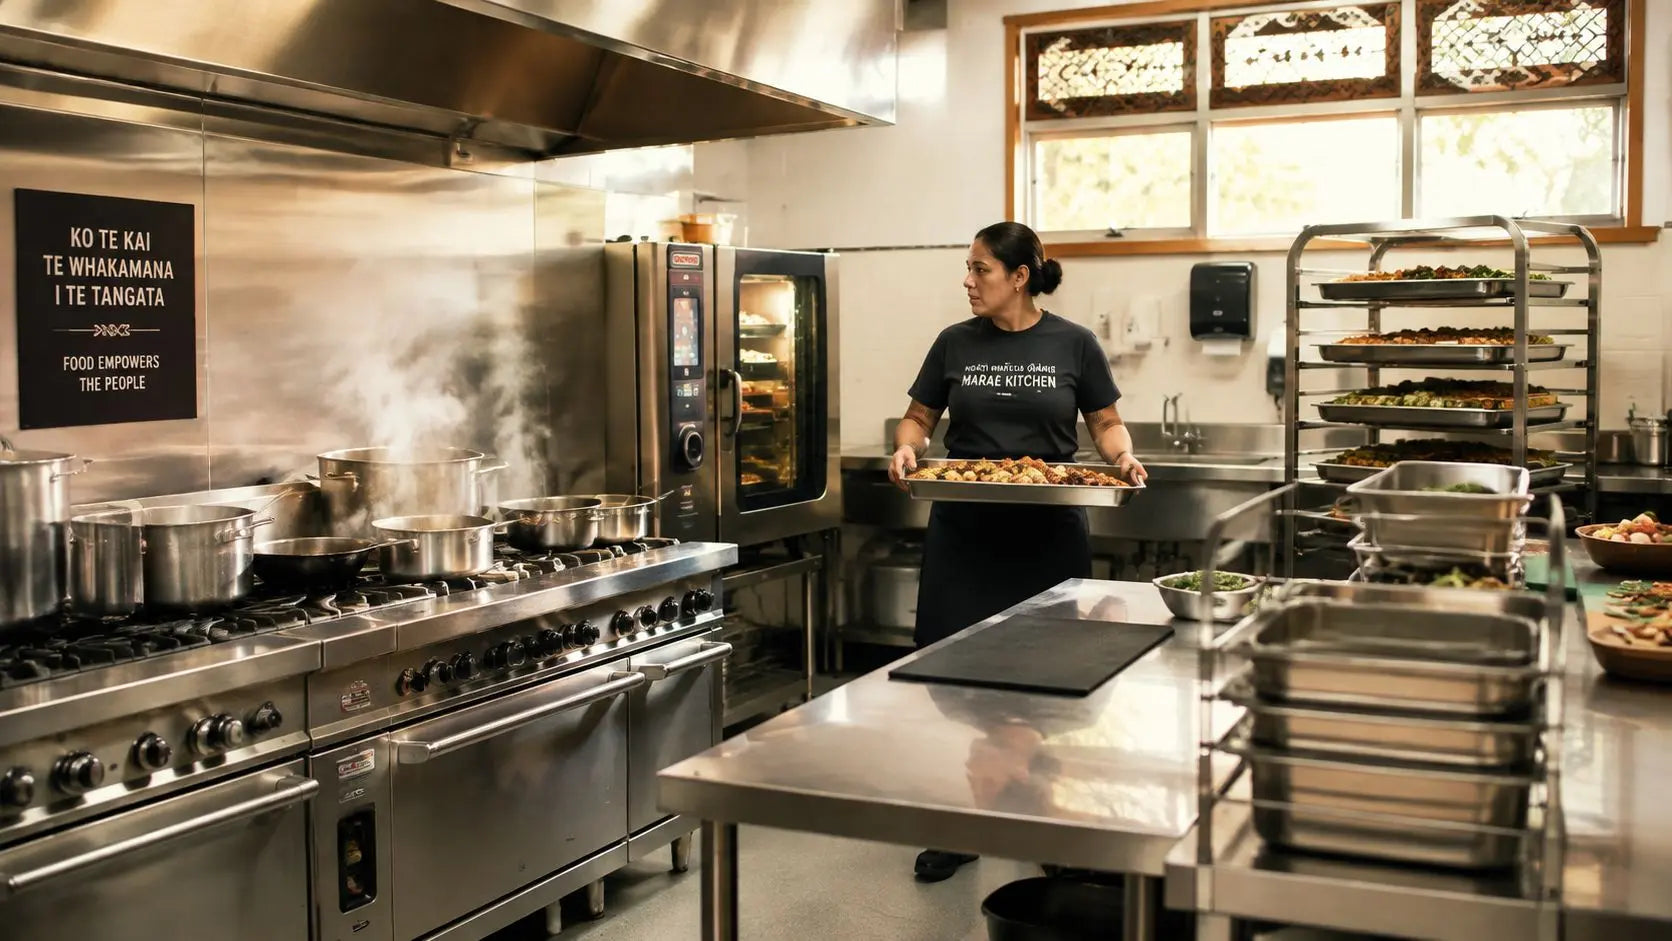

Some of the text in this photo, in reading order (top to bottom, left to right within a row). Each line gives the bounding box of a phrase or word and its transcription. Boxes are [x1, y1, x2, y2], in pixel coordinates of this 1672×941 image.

[70, 227, 150, 251] KO TE KAI
[43, 255, 174, 279] TE WHAKAMANA
[55, 286, 165, 306] I TE TANGATA
[63, 355, 160, 371] FOOD EMPOWERS
[79, 375, 146, 392] THE PEOPLE
[962, 374, 1056, 388] MARAE KITCHEN
